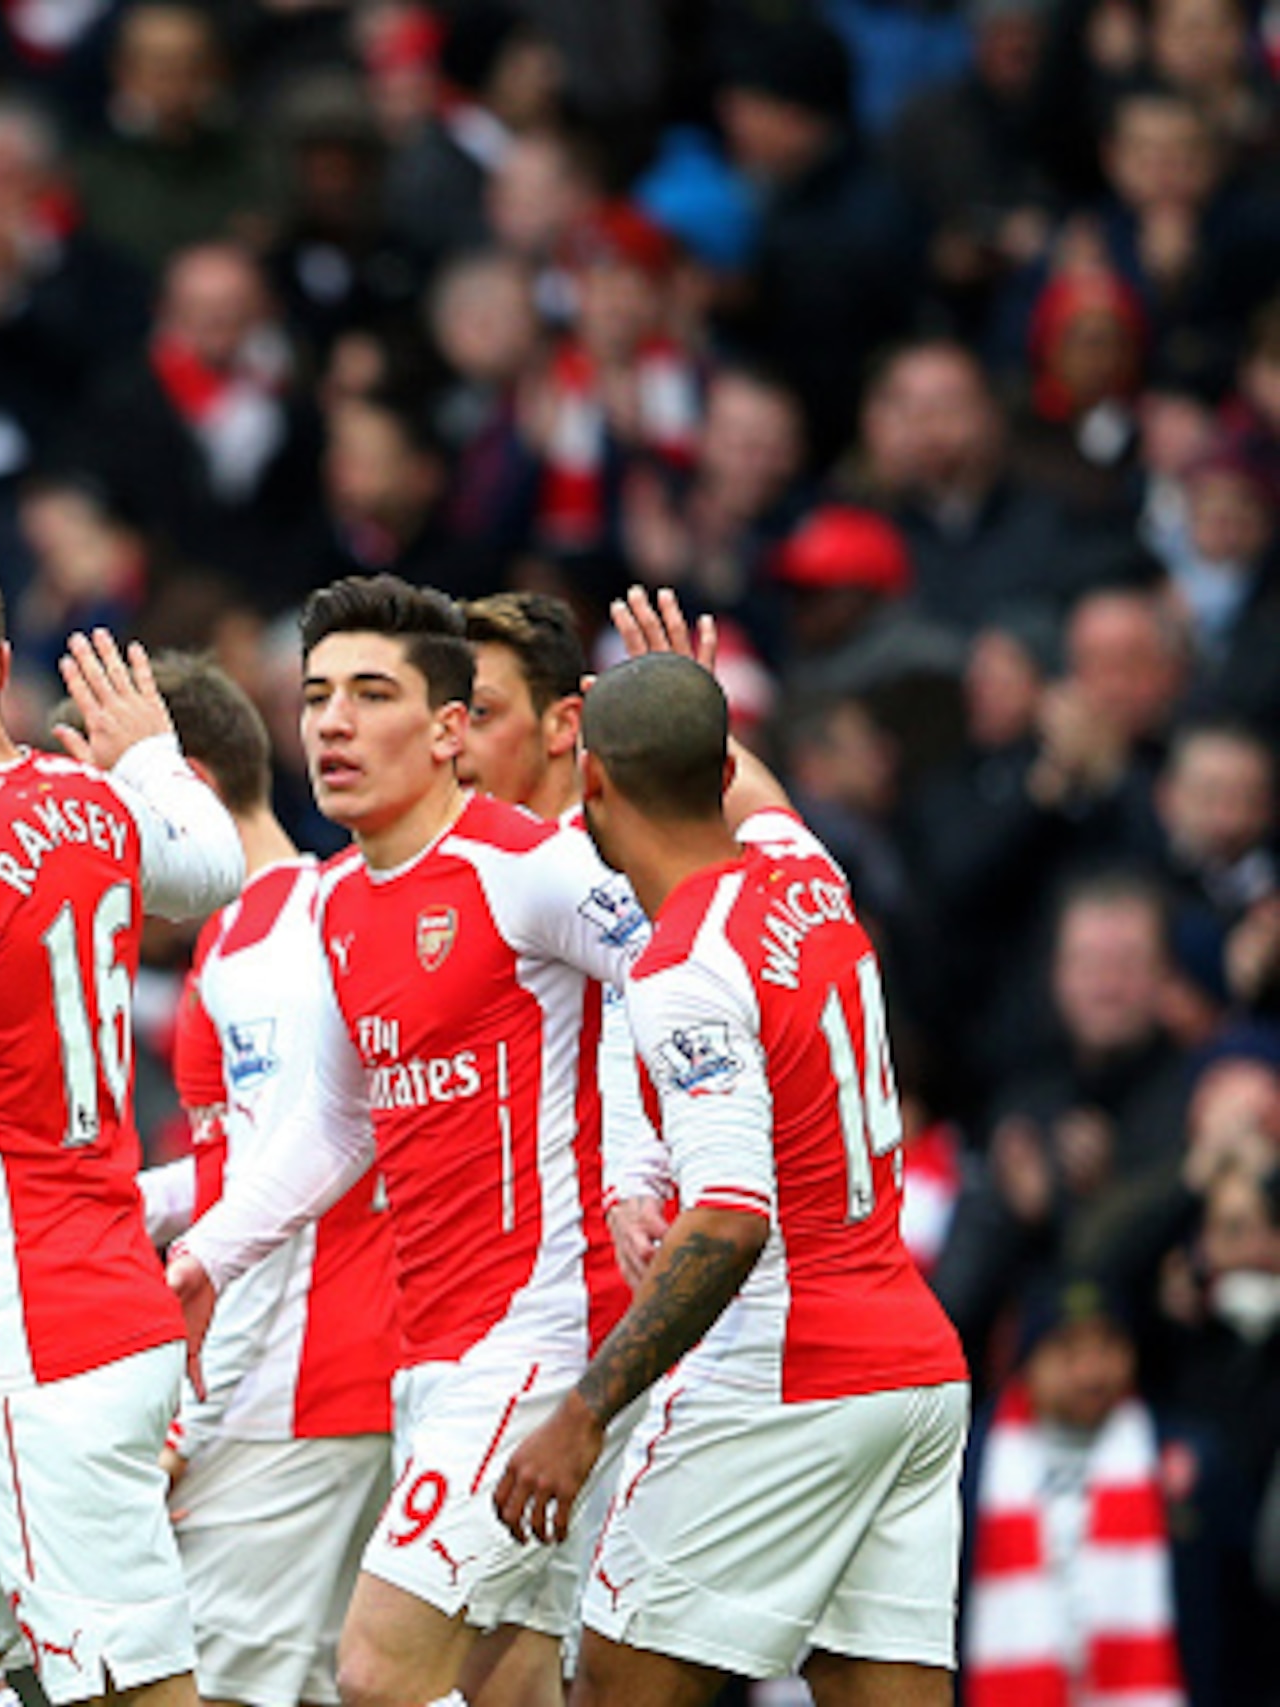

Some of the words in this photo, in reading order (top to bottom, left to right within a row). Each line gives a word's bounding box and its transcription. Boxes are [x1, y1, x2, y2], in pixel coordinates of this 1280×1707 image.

[40, 879, 131, 1147] 16
[358, 1015, 399, 1058] Fly
[820, 951, 903, 1223] 14
